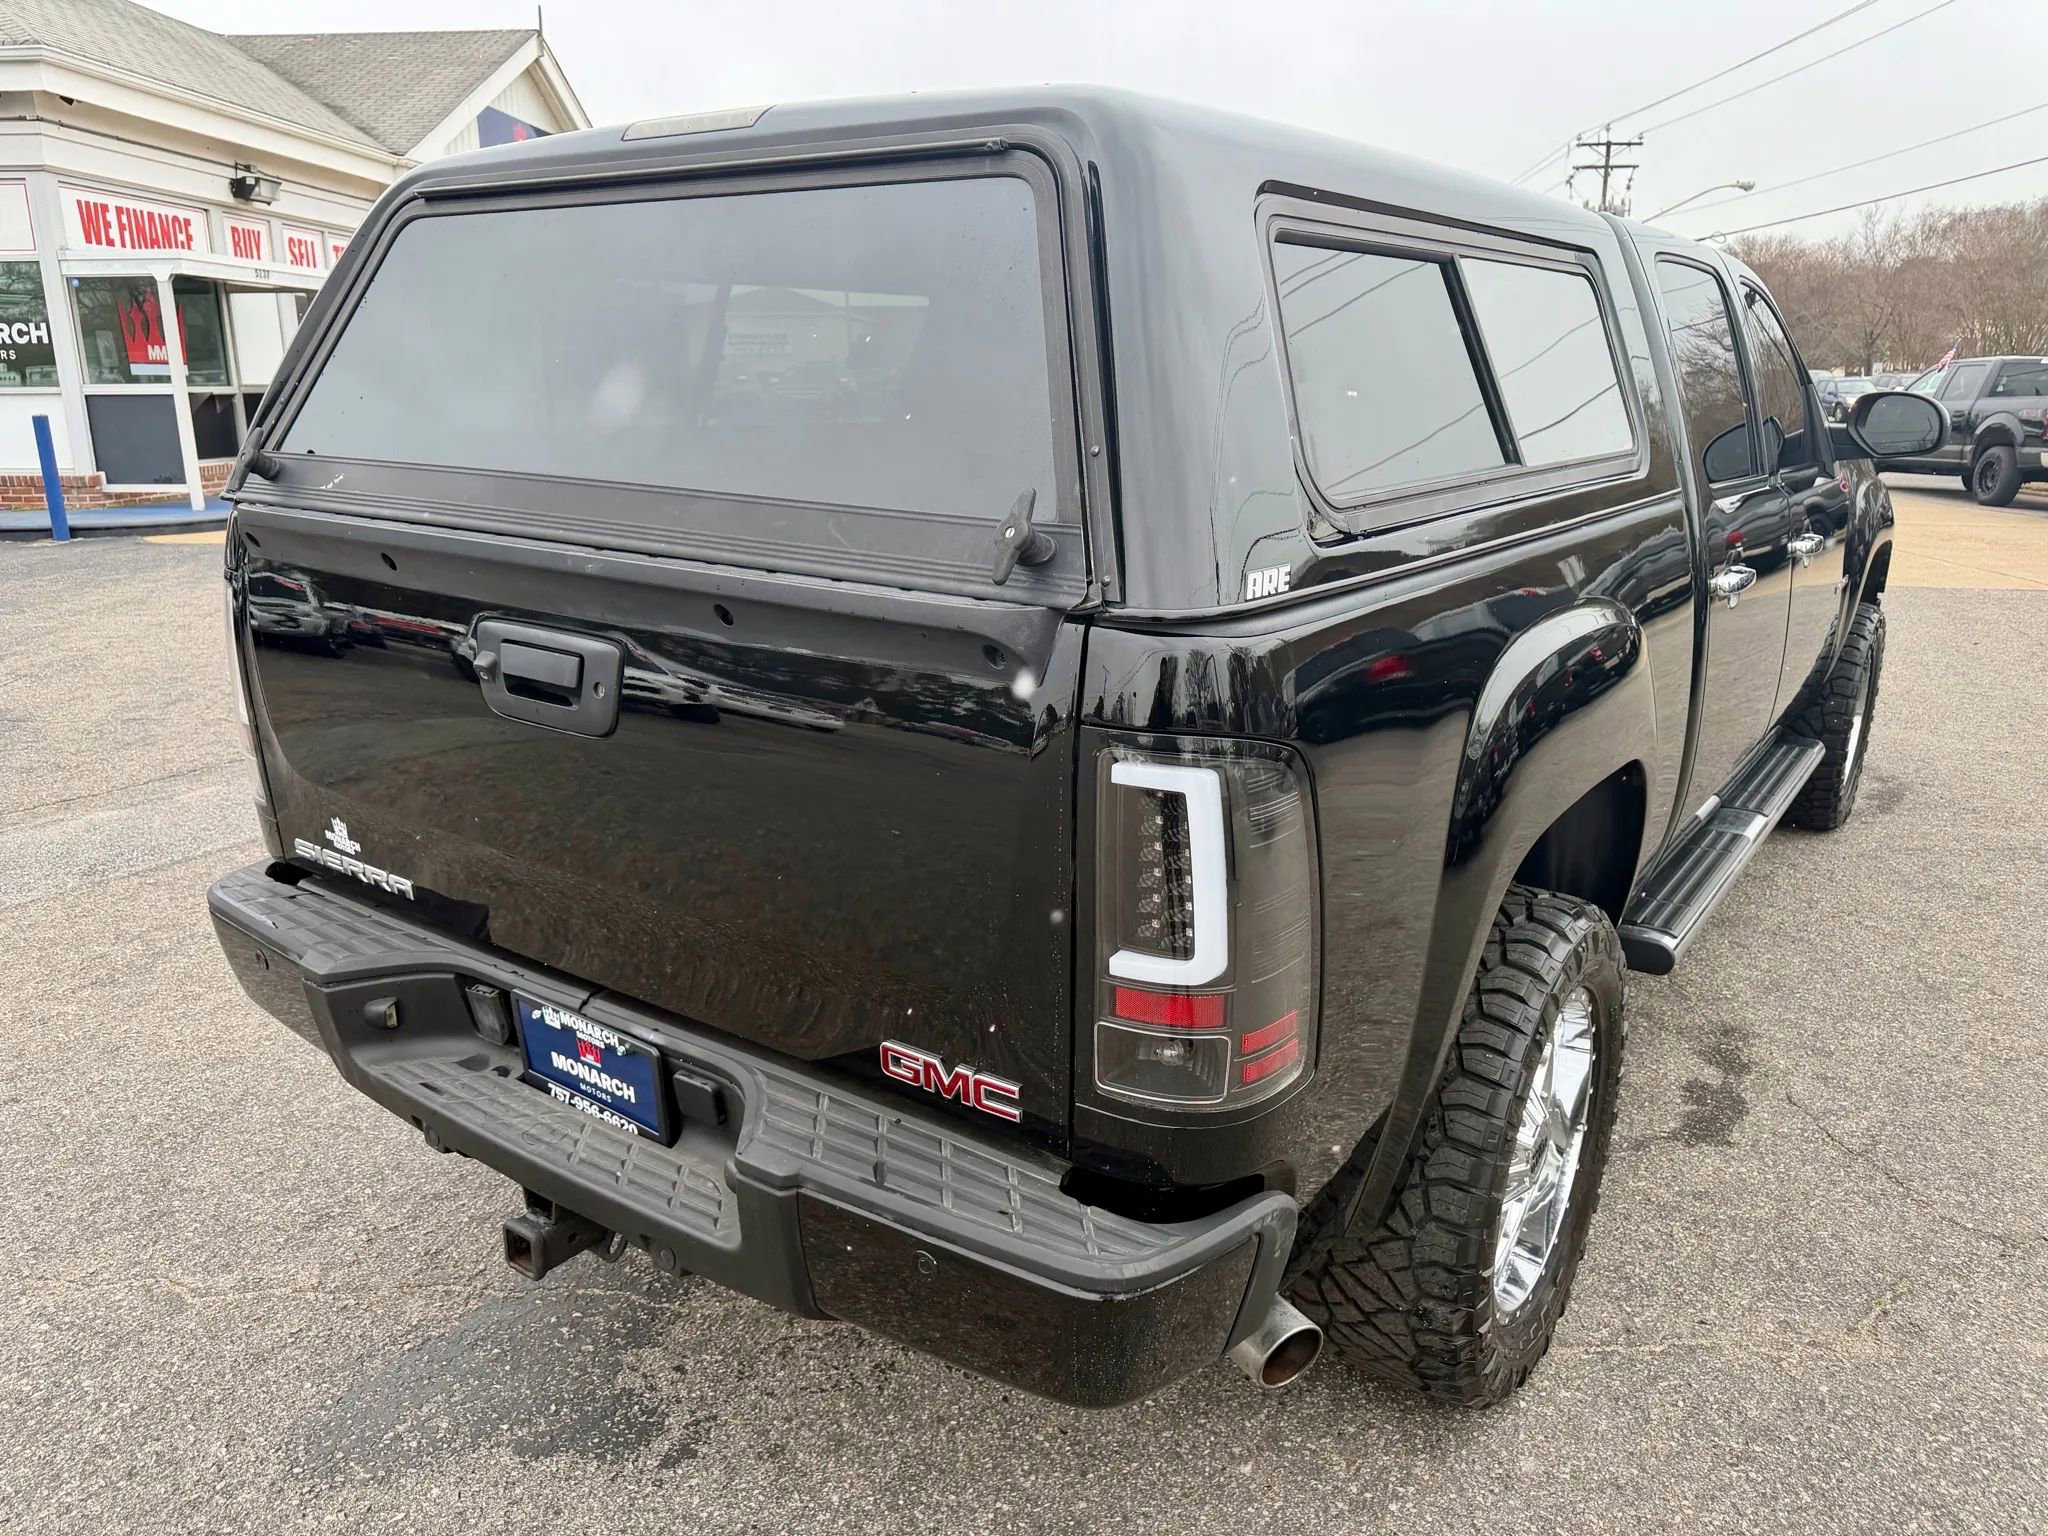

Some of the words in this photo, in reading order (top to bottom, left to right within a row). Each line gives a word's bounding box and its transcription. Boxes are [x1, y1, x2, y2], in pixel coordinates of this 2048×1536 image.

[76, 199, 115, 247] WE
[115, 205, 193, 251] FINANCE
[230, 225, 261, 260] BUY
[288, 236, 317, 269] SELL
[1246, 564, 1291, 600] ARE
[294, 838, 415, 901] SIERRA
[560, 1011, 619, 1047] MONARCH
[576, 1031, 605, 1049] MOTORS
[551, 1051, 636, 1103] MONARCH
[579, 1082, 612, 1103] MOTORS
[880, 1041, 1023, 1124] GMC
[548, 1083, 638, 1135] 757-956-6620
